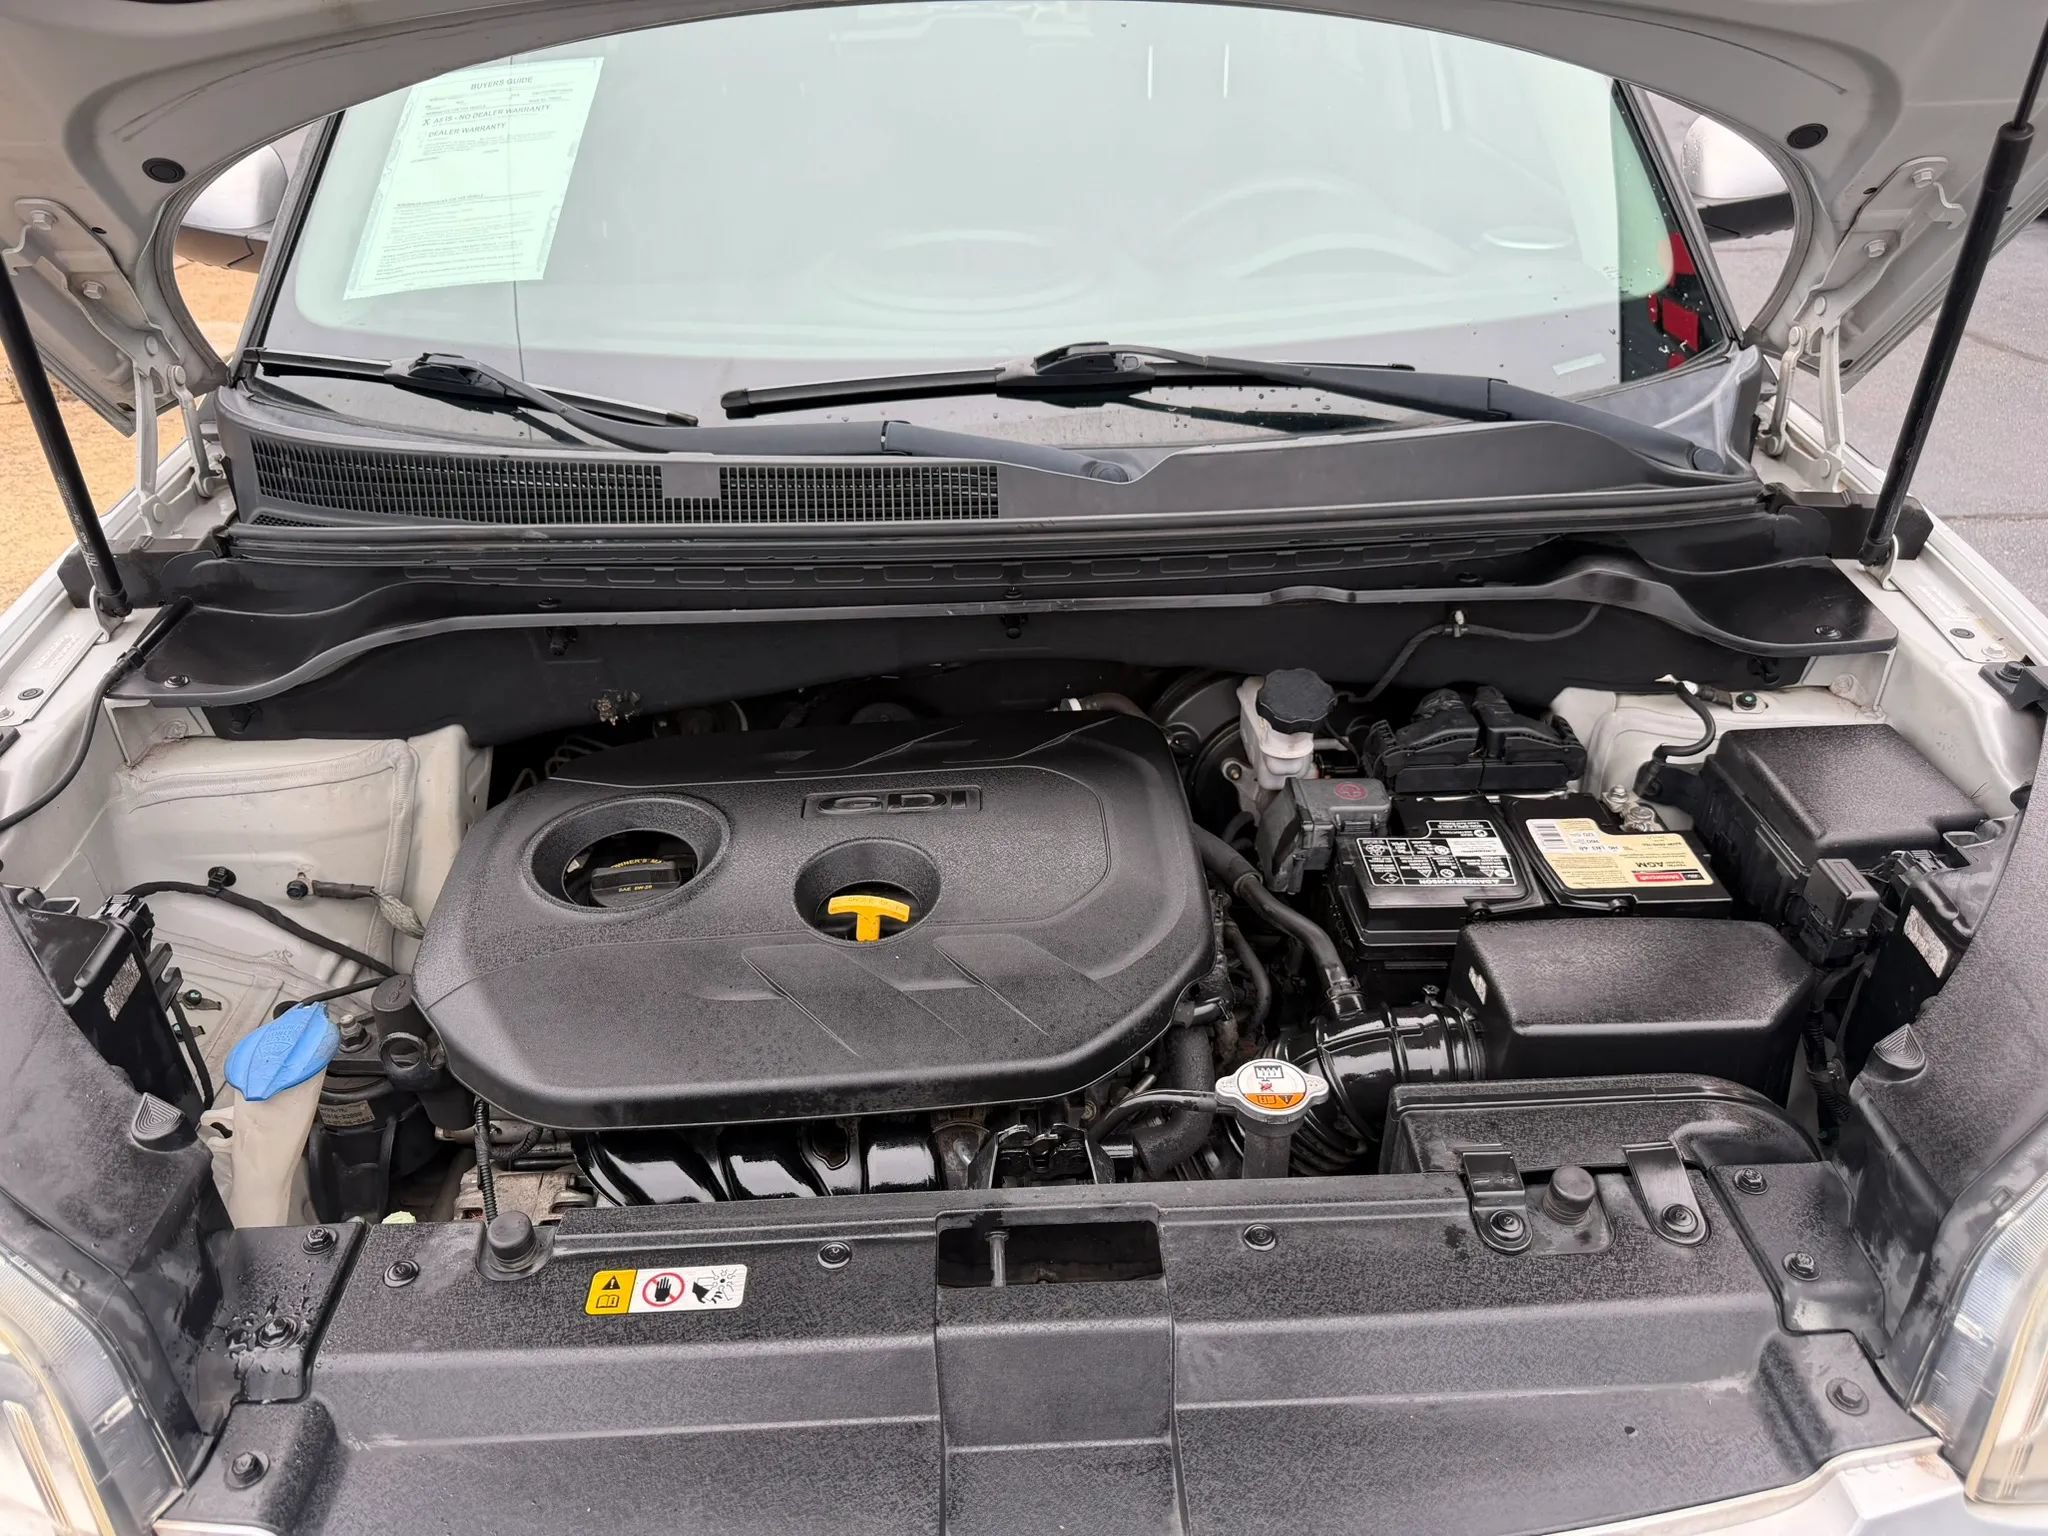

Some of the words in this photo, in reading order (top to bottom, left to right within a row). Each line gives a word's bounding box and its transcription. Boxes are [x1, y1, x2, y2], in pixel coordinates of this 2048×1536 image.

[470, 79, 504, 90] BUYERS
[506, 76, 534, 86] GUIDE
[458, 113, 472, 121] NO
[472, 108, 504, 119] DEALER
[505, 104, 552, 115] WARRANTY
[428, 128, 460, 138] DEALER
[461, 122, 507, 134] WARRANTY
